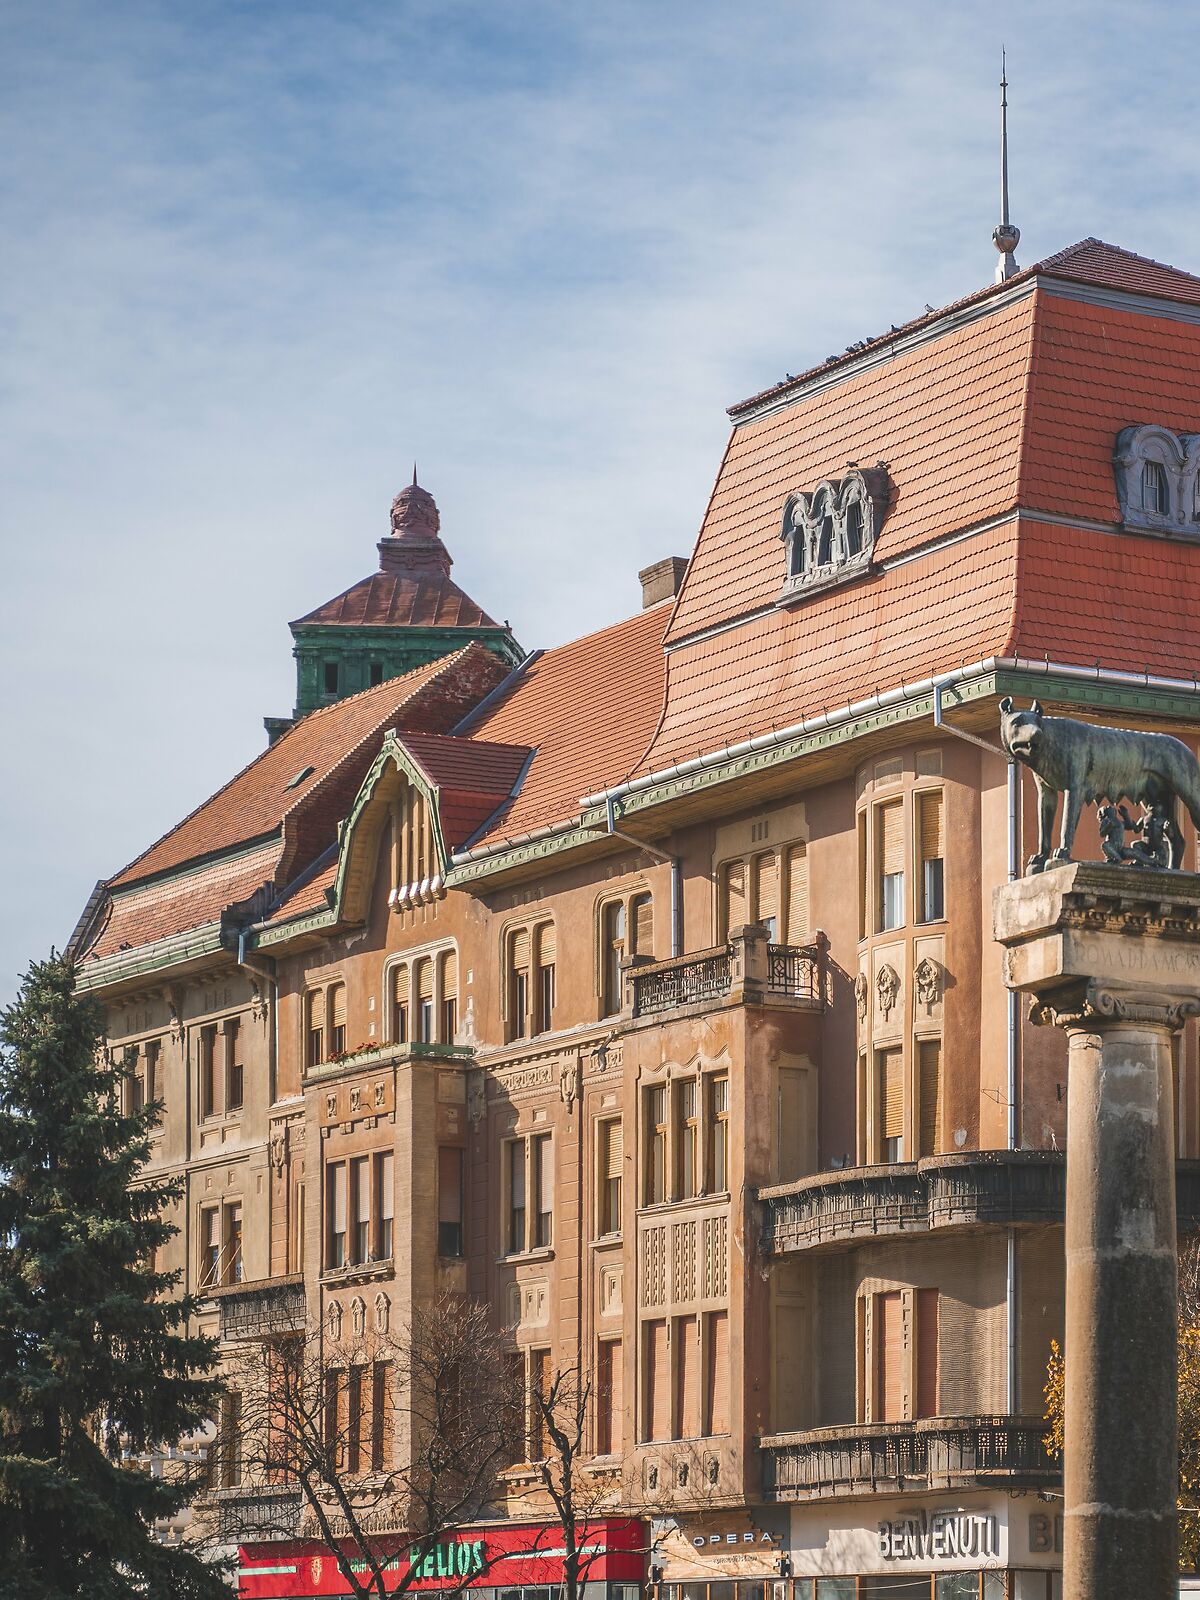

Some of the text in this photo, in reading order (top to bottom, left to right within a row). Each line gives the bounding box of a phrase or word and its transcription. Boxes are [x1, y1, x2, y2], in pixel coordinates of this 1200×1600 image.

[693, 1532, 773, 1547] OPERA
[878, 1510, 996, 1558] BENVENUTI
[410, 1541, 484, 1578] HELIOS
